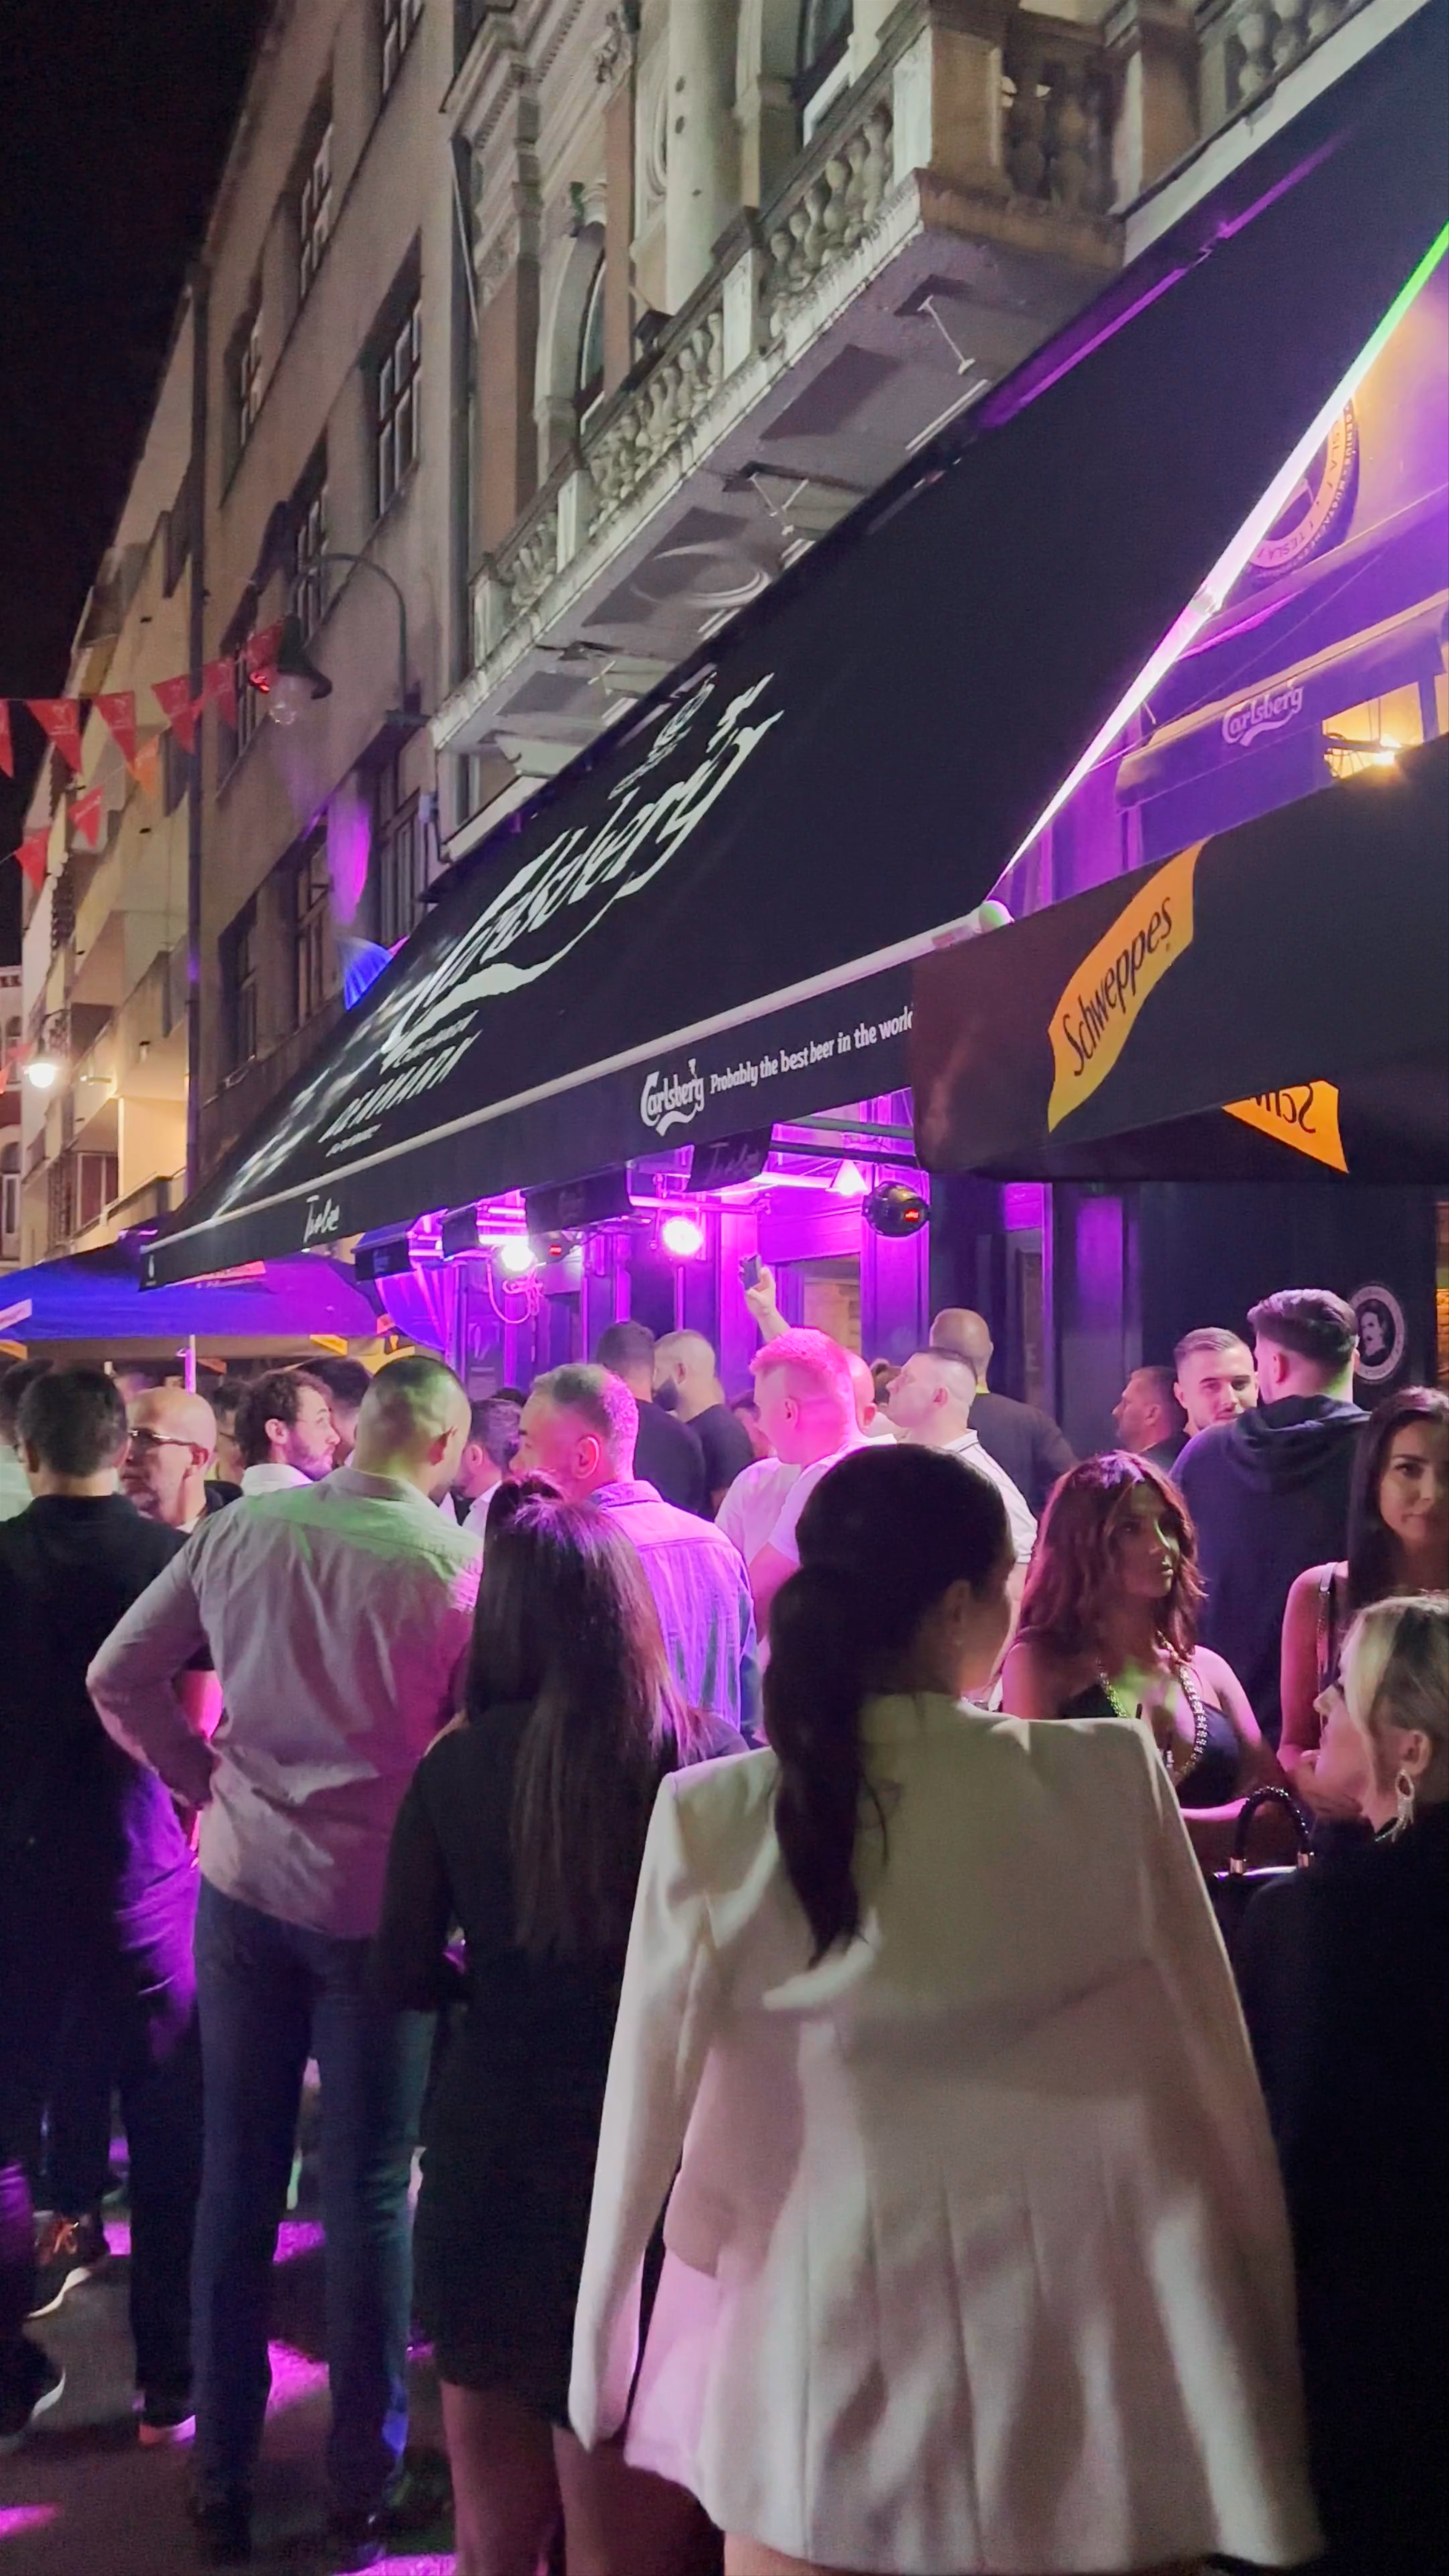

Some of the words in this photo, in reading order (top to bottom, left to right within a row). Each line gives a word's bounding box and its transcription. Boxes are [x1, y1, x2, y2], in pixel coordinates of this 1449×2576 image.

[1268, 531, 1306, 560] TESLA
[1221, 676, 1304, 746] Carlsberg
[379, 672, 785, 1075] Carlsberg
[1063, 897, 1173, 1077] Schweppes
[710, 1061, 758, 1093] Probably
[760, 1056, 778, 1078] the
[780, 1050, 809, 1072] best
[810, 1041, 835, 1063] beer
[837, 1032, 851, 1053] in
[854, 1022, 877, 1049] the
[640, 1058, 705, 1137] Carlsberg
